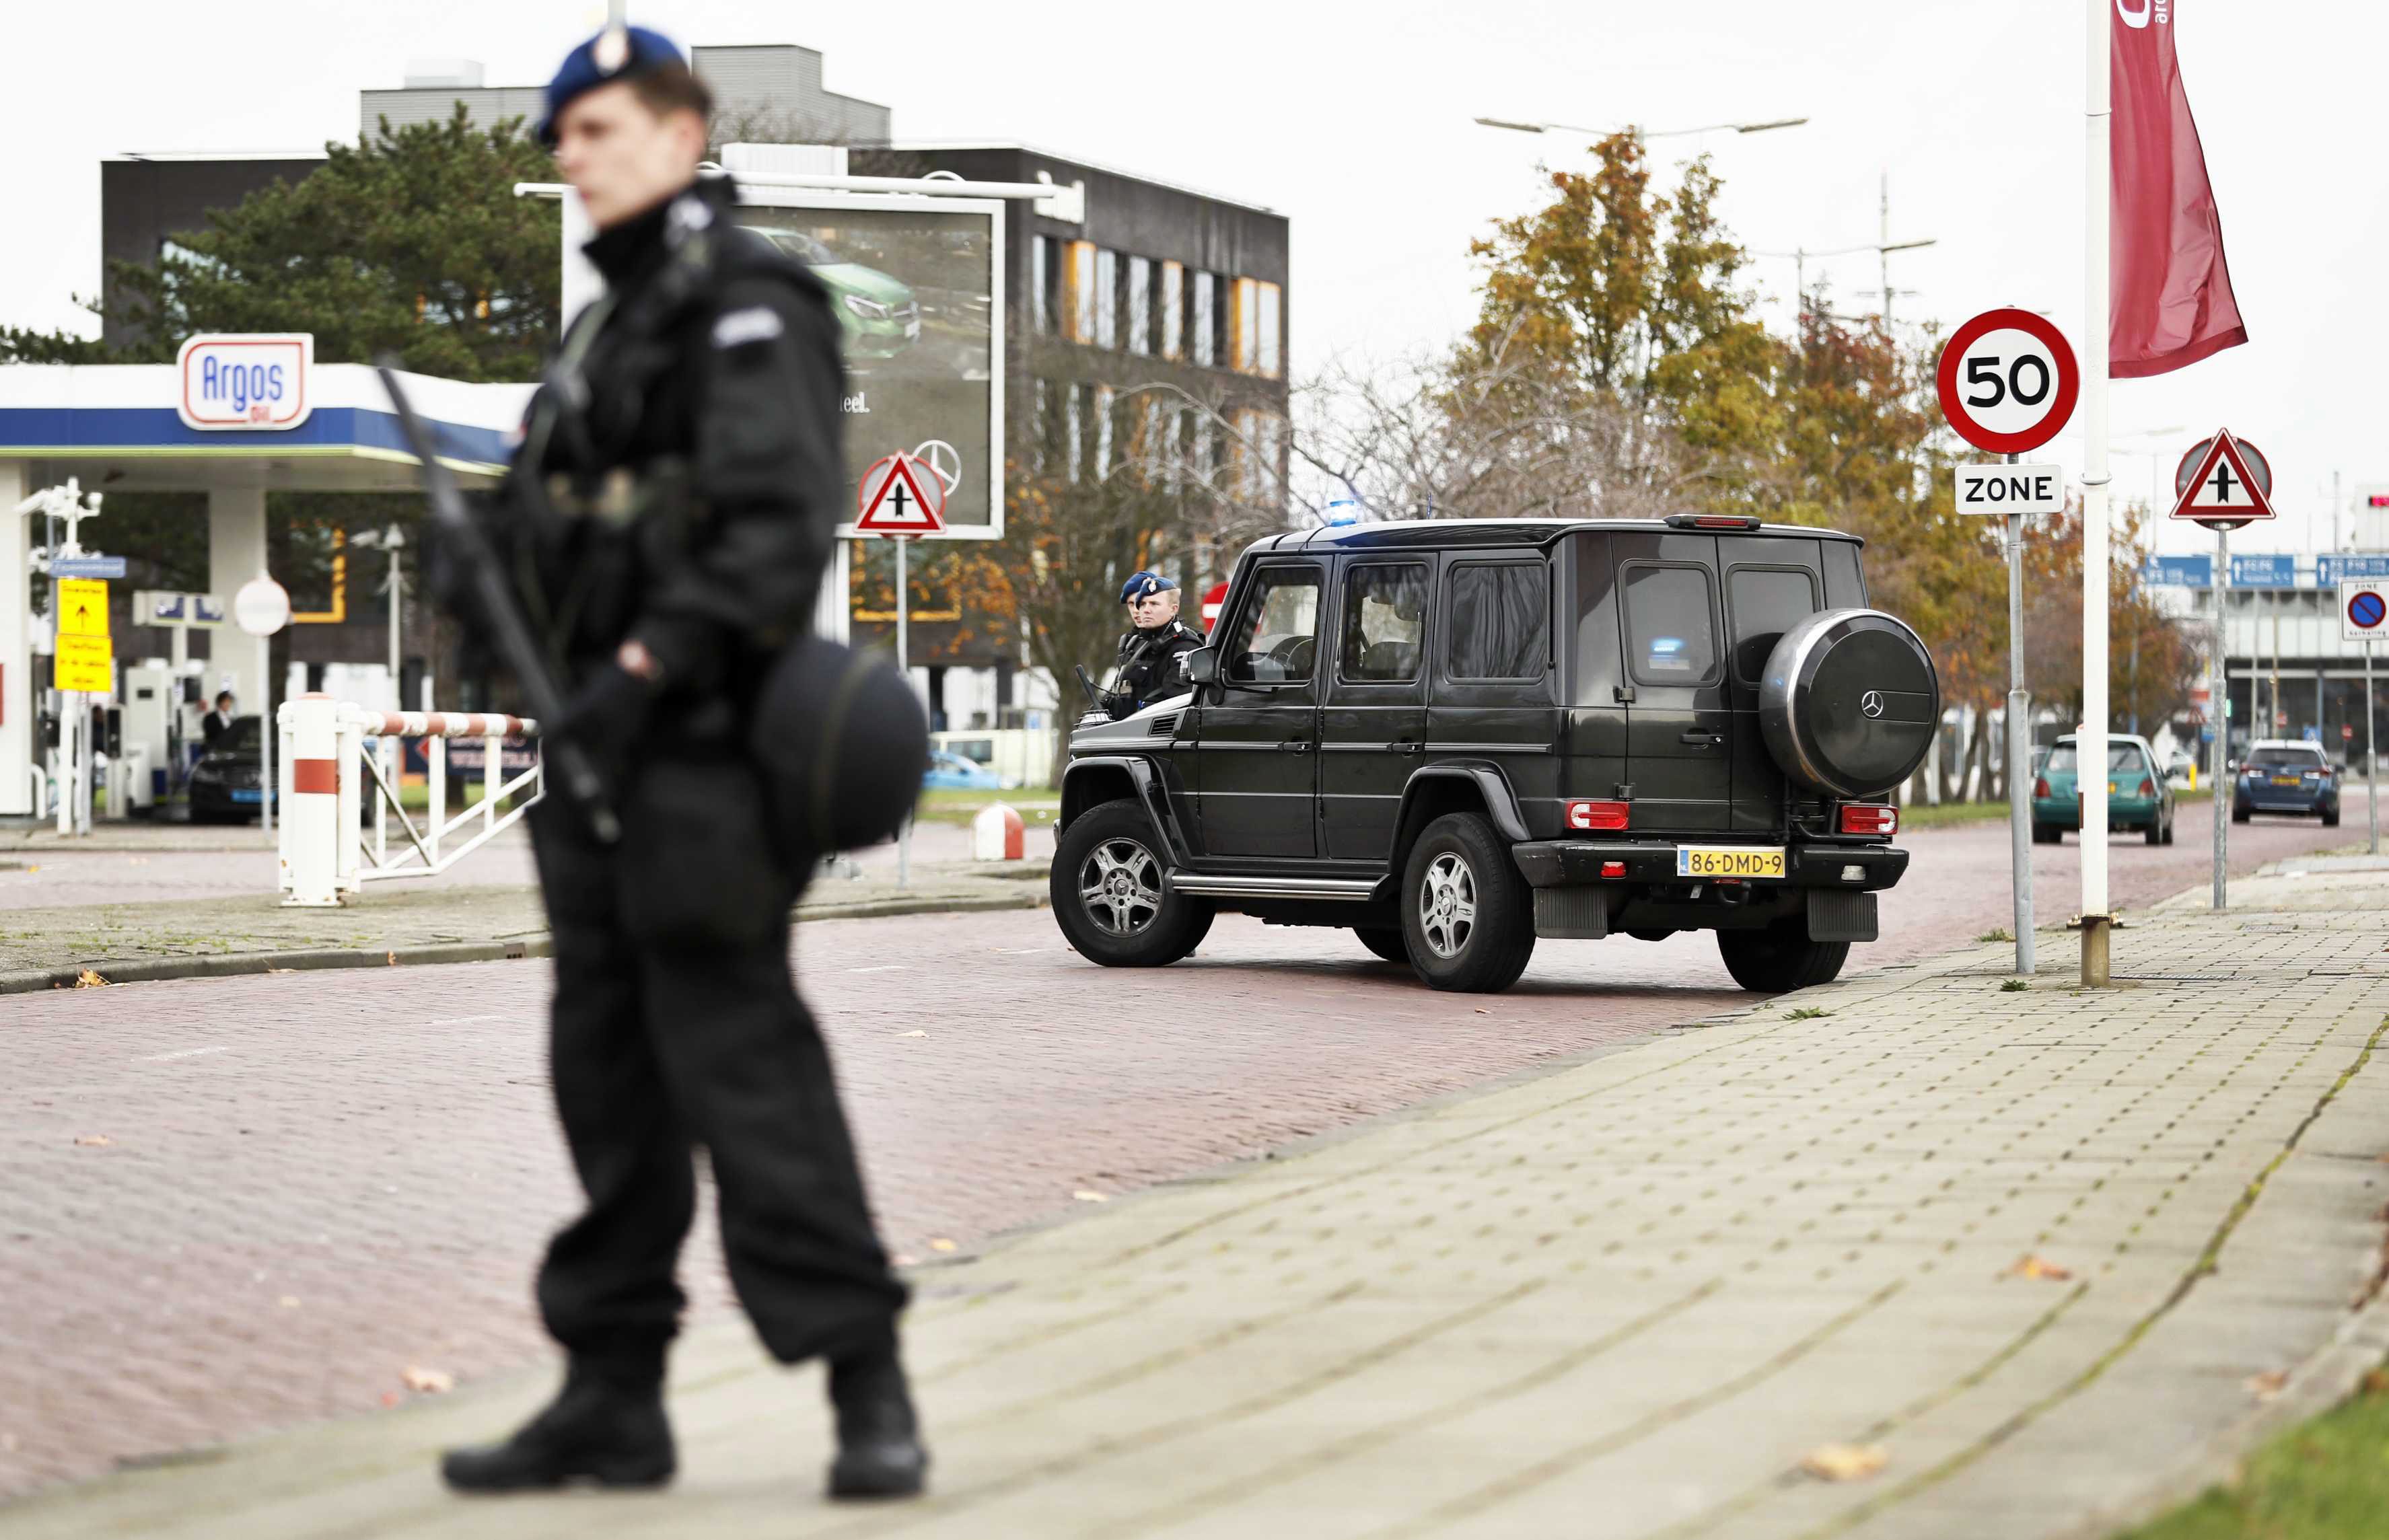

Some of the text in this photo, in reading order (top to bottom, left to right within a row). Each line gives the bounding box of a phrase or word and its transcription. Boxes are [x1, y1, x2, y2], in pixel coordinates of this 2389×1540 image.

[203, 355, 283, 412] Argos
[1966, 354, 2050, 408] 50
[1965, 476, 2053, 503] ZONE
[1691, 853, 1782, 873] 86-DMD-9
